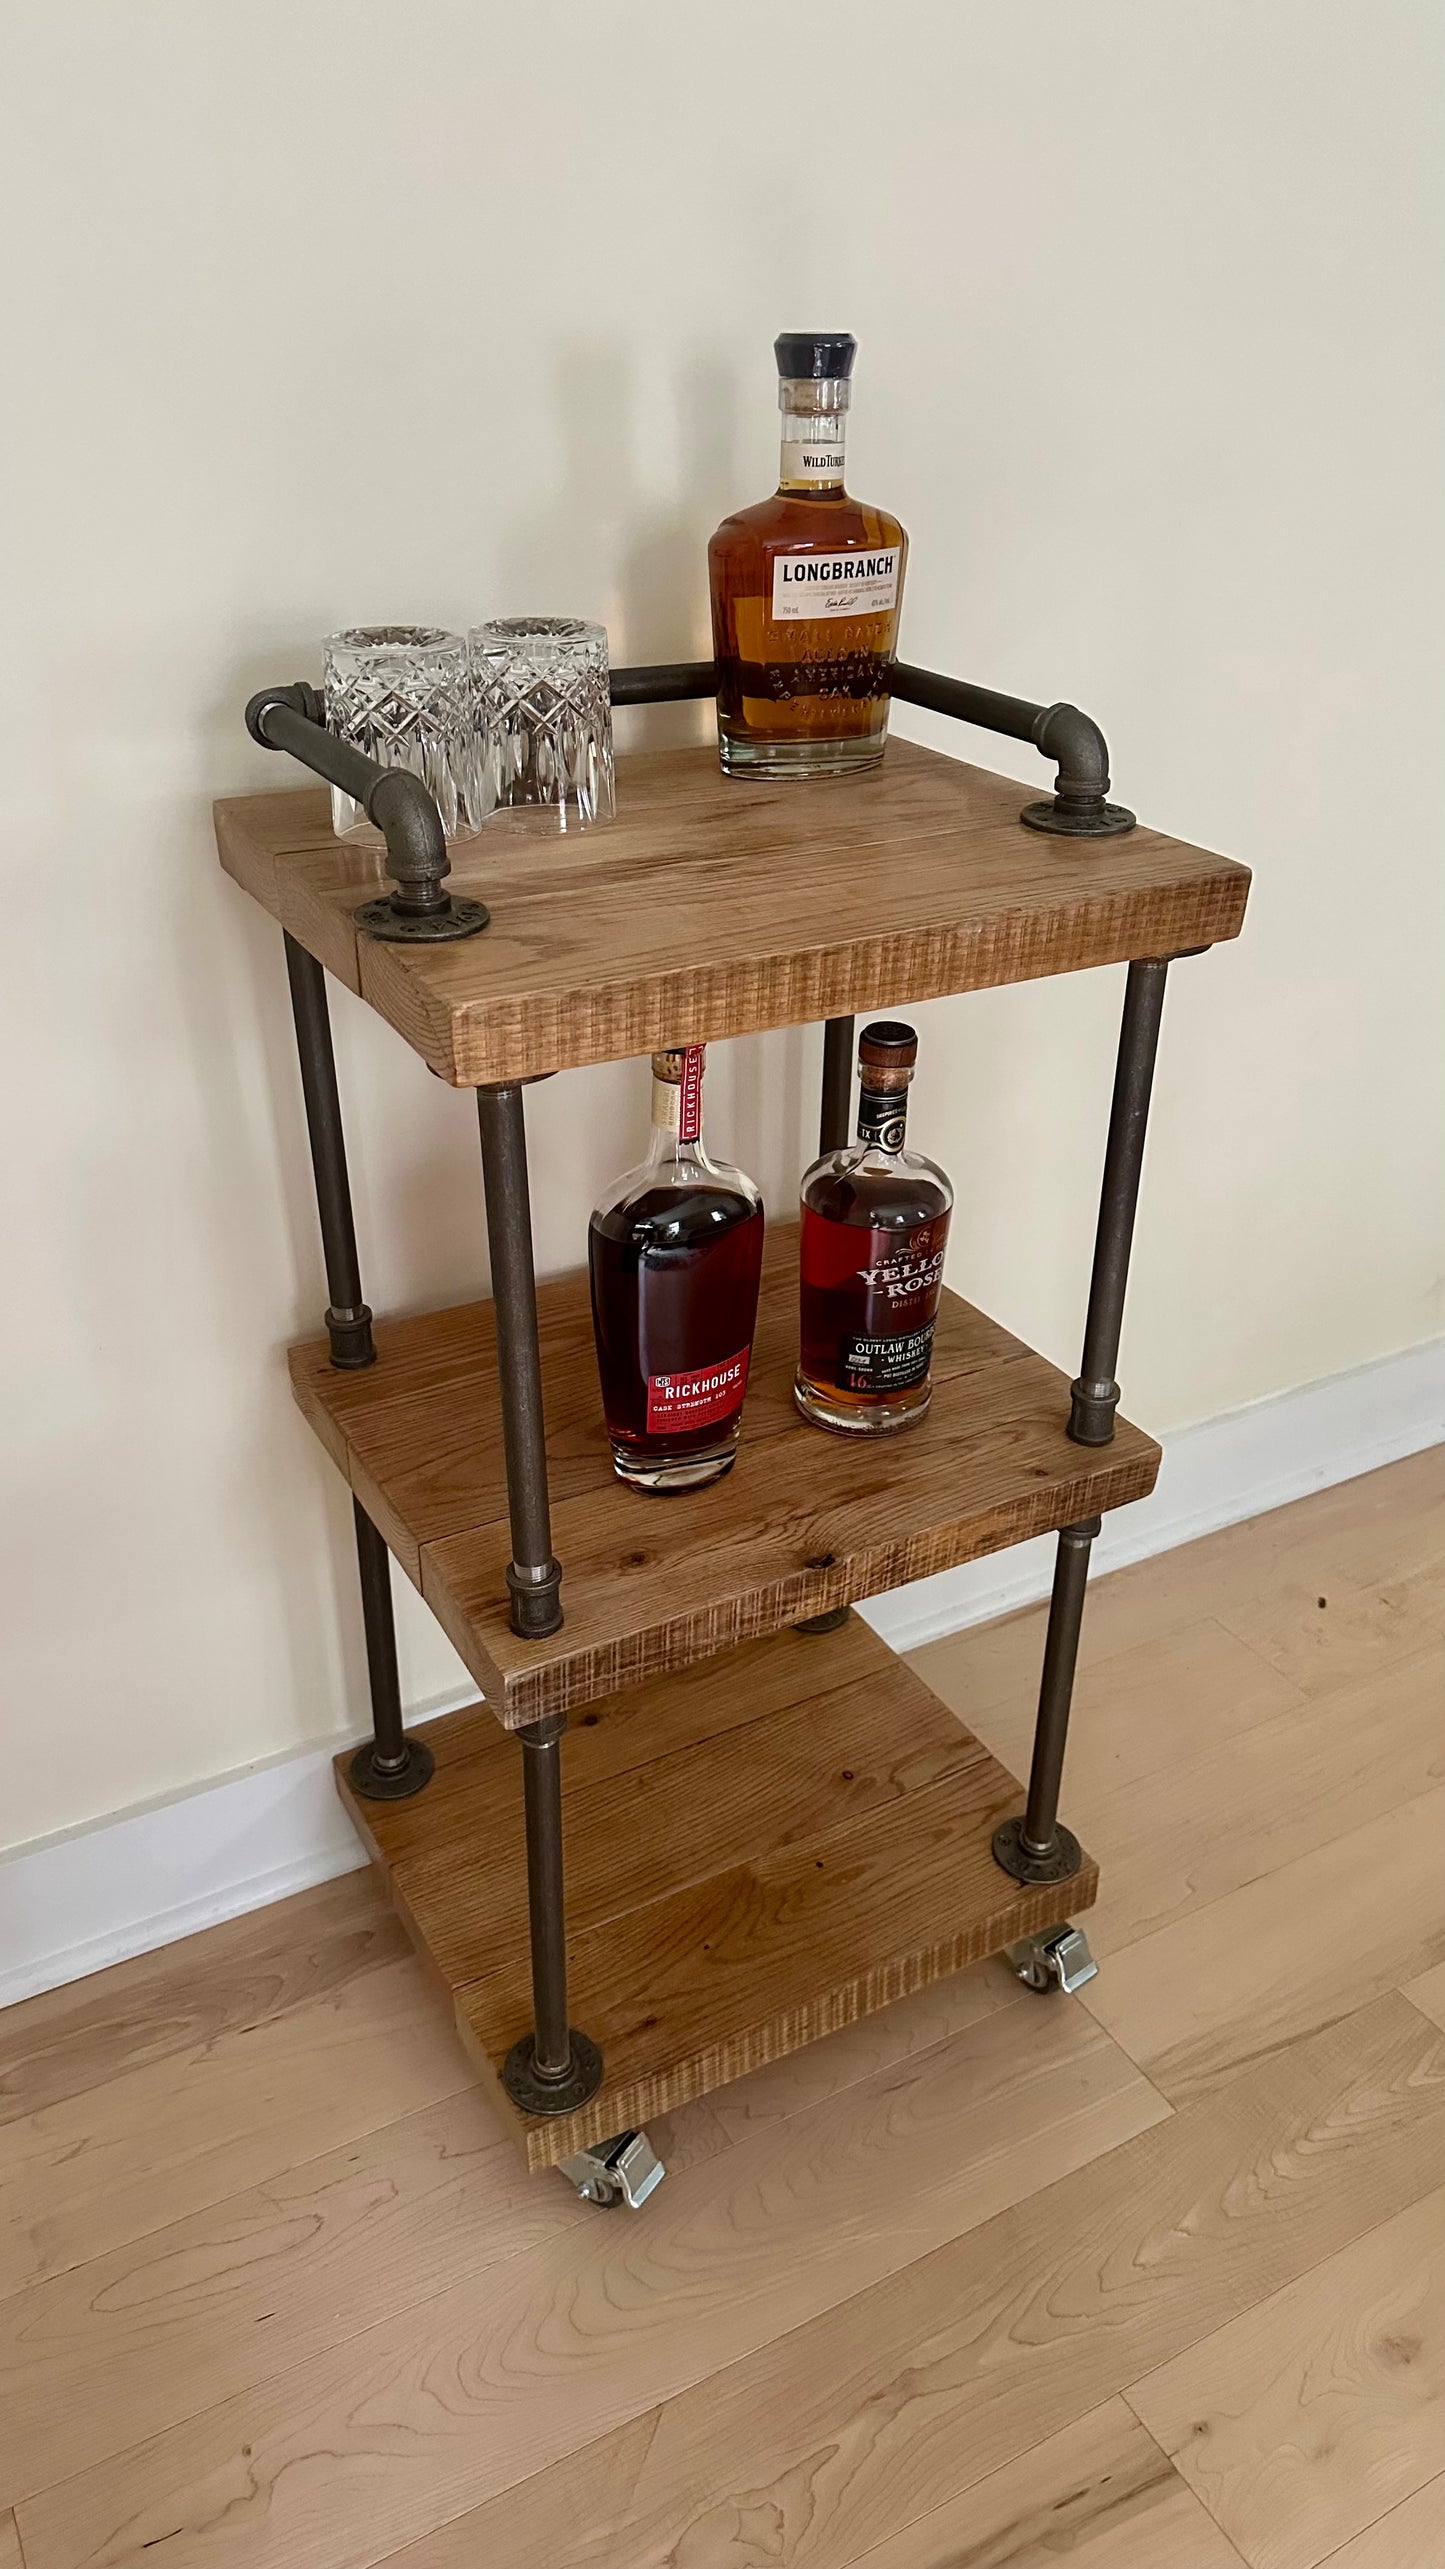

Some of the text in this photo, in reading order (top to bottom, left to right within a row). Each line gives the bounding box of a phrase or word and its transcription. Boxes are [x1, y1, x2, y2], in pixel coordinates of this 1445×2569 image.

[803, 455, 826, 467] WILD
[783, 556, 893, 582] LONGBRANCH
[686, 1057, 697, 1133] RICKHOUSE
[856, 1250, 944, 1286] YELLO
[875, 1252, 922, 1267] CRAFTED
[886, 1267, 942, 1299] ROSE
[855, 1341, 905, 1355] OUTLAW
[887, 1345, 926, 1364] WHISKEY
[665, 1363, 741, 1399] RICKHOUSE
[849, 1373, 867, 1389] 16
